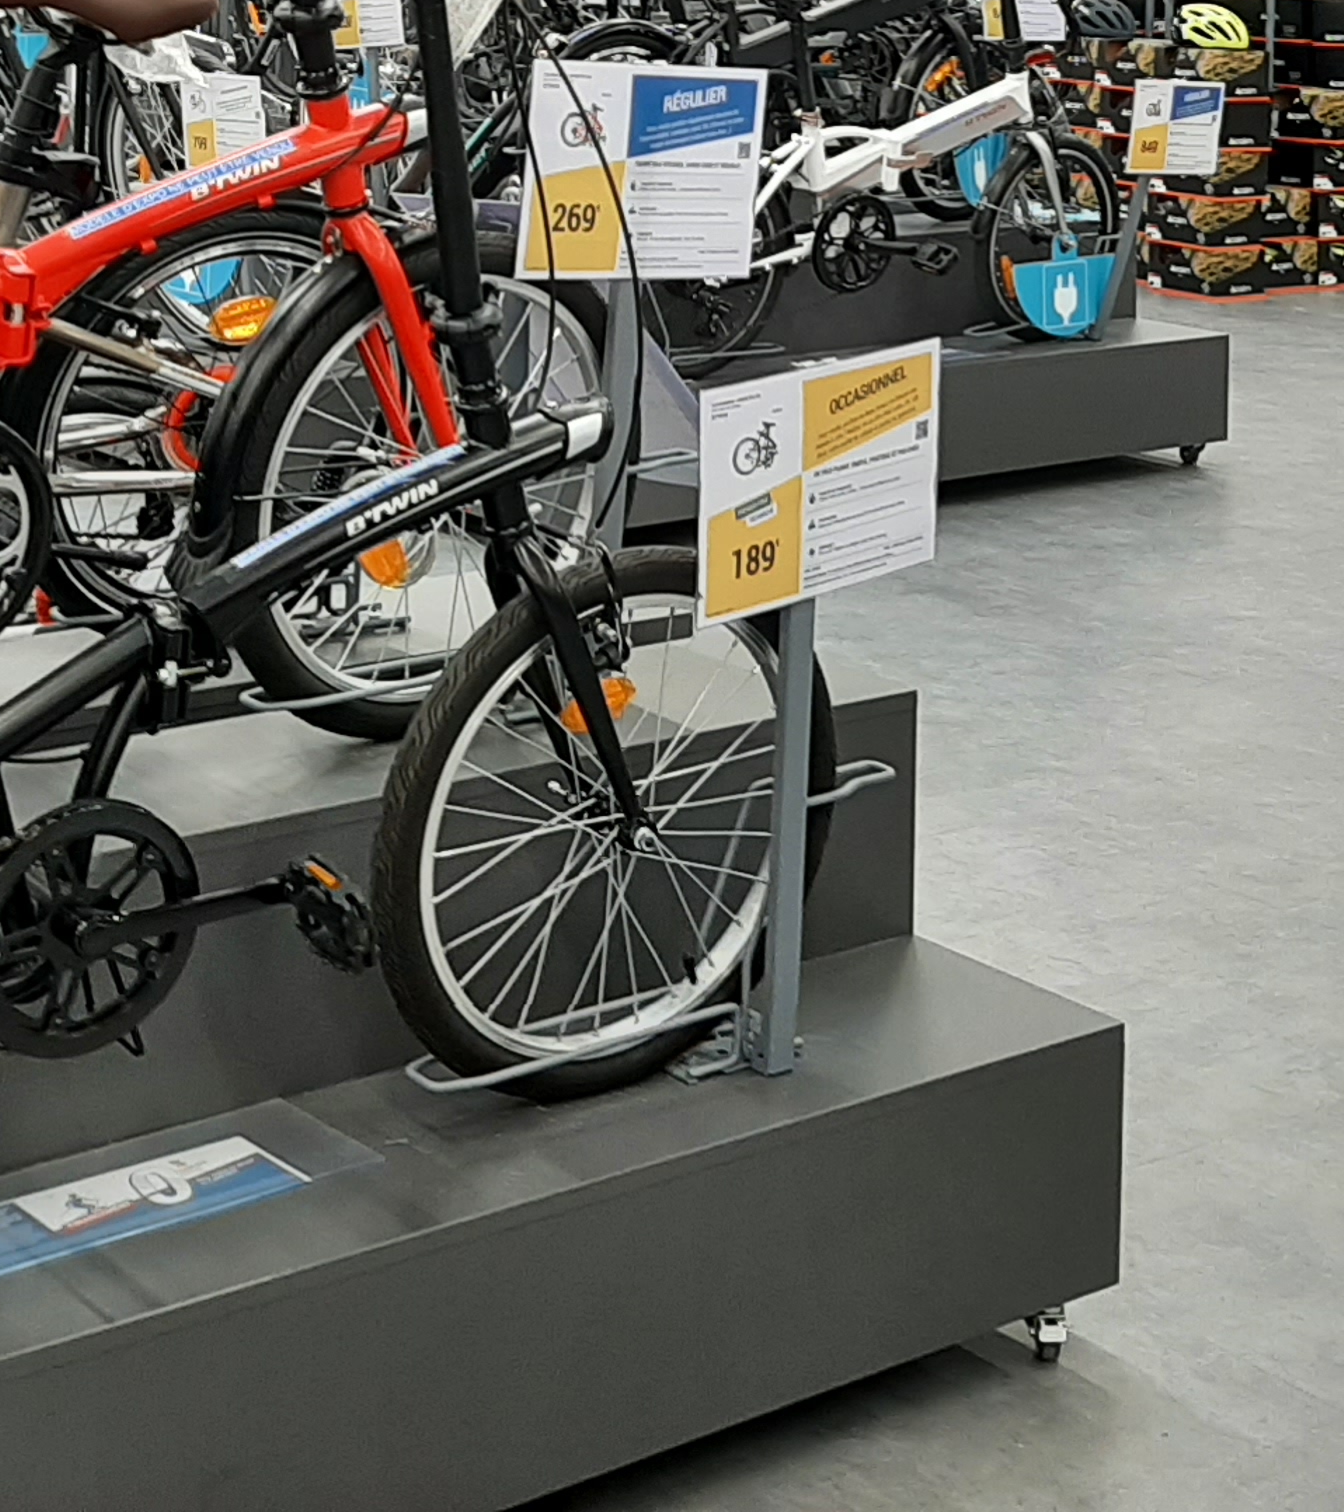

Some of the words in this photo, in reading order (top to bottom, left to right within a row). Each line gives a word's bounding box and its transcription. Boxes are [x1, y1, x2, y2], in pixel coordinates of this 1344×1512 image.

[663, 85, 727, 113] RÉGULIER
[191, 155, 282, 201] B'TWIN
[828, 365, 908, 415] OCCASIONNEL
[345, 478, 439, 538] B'TWIN
